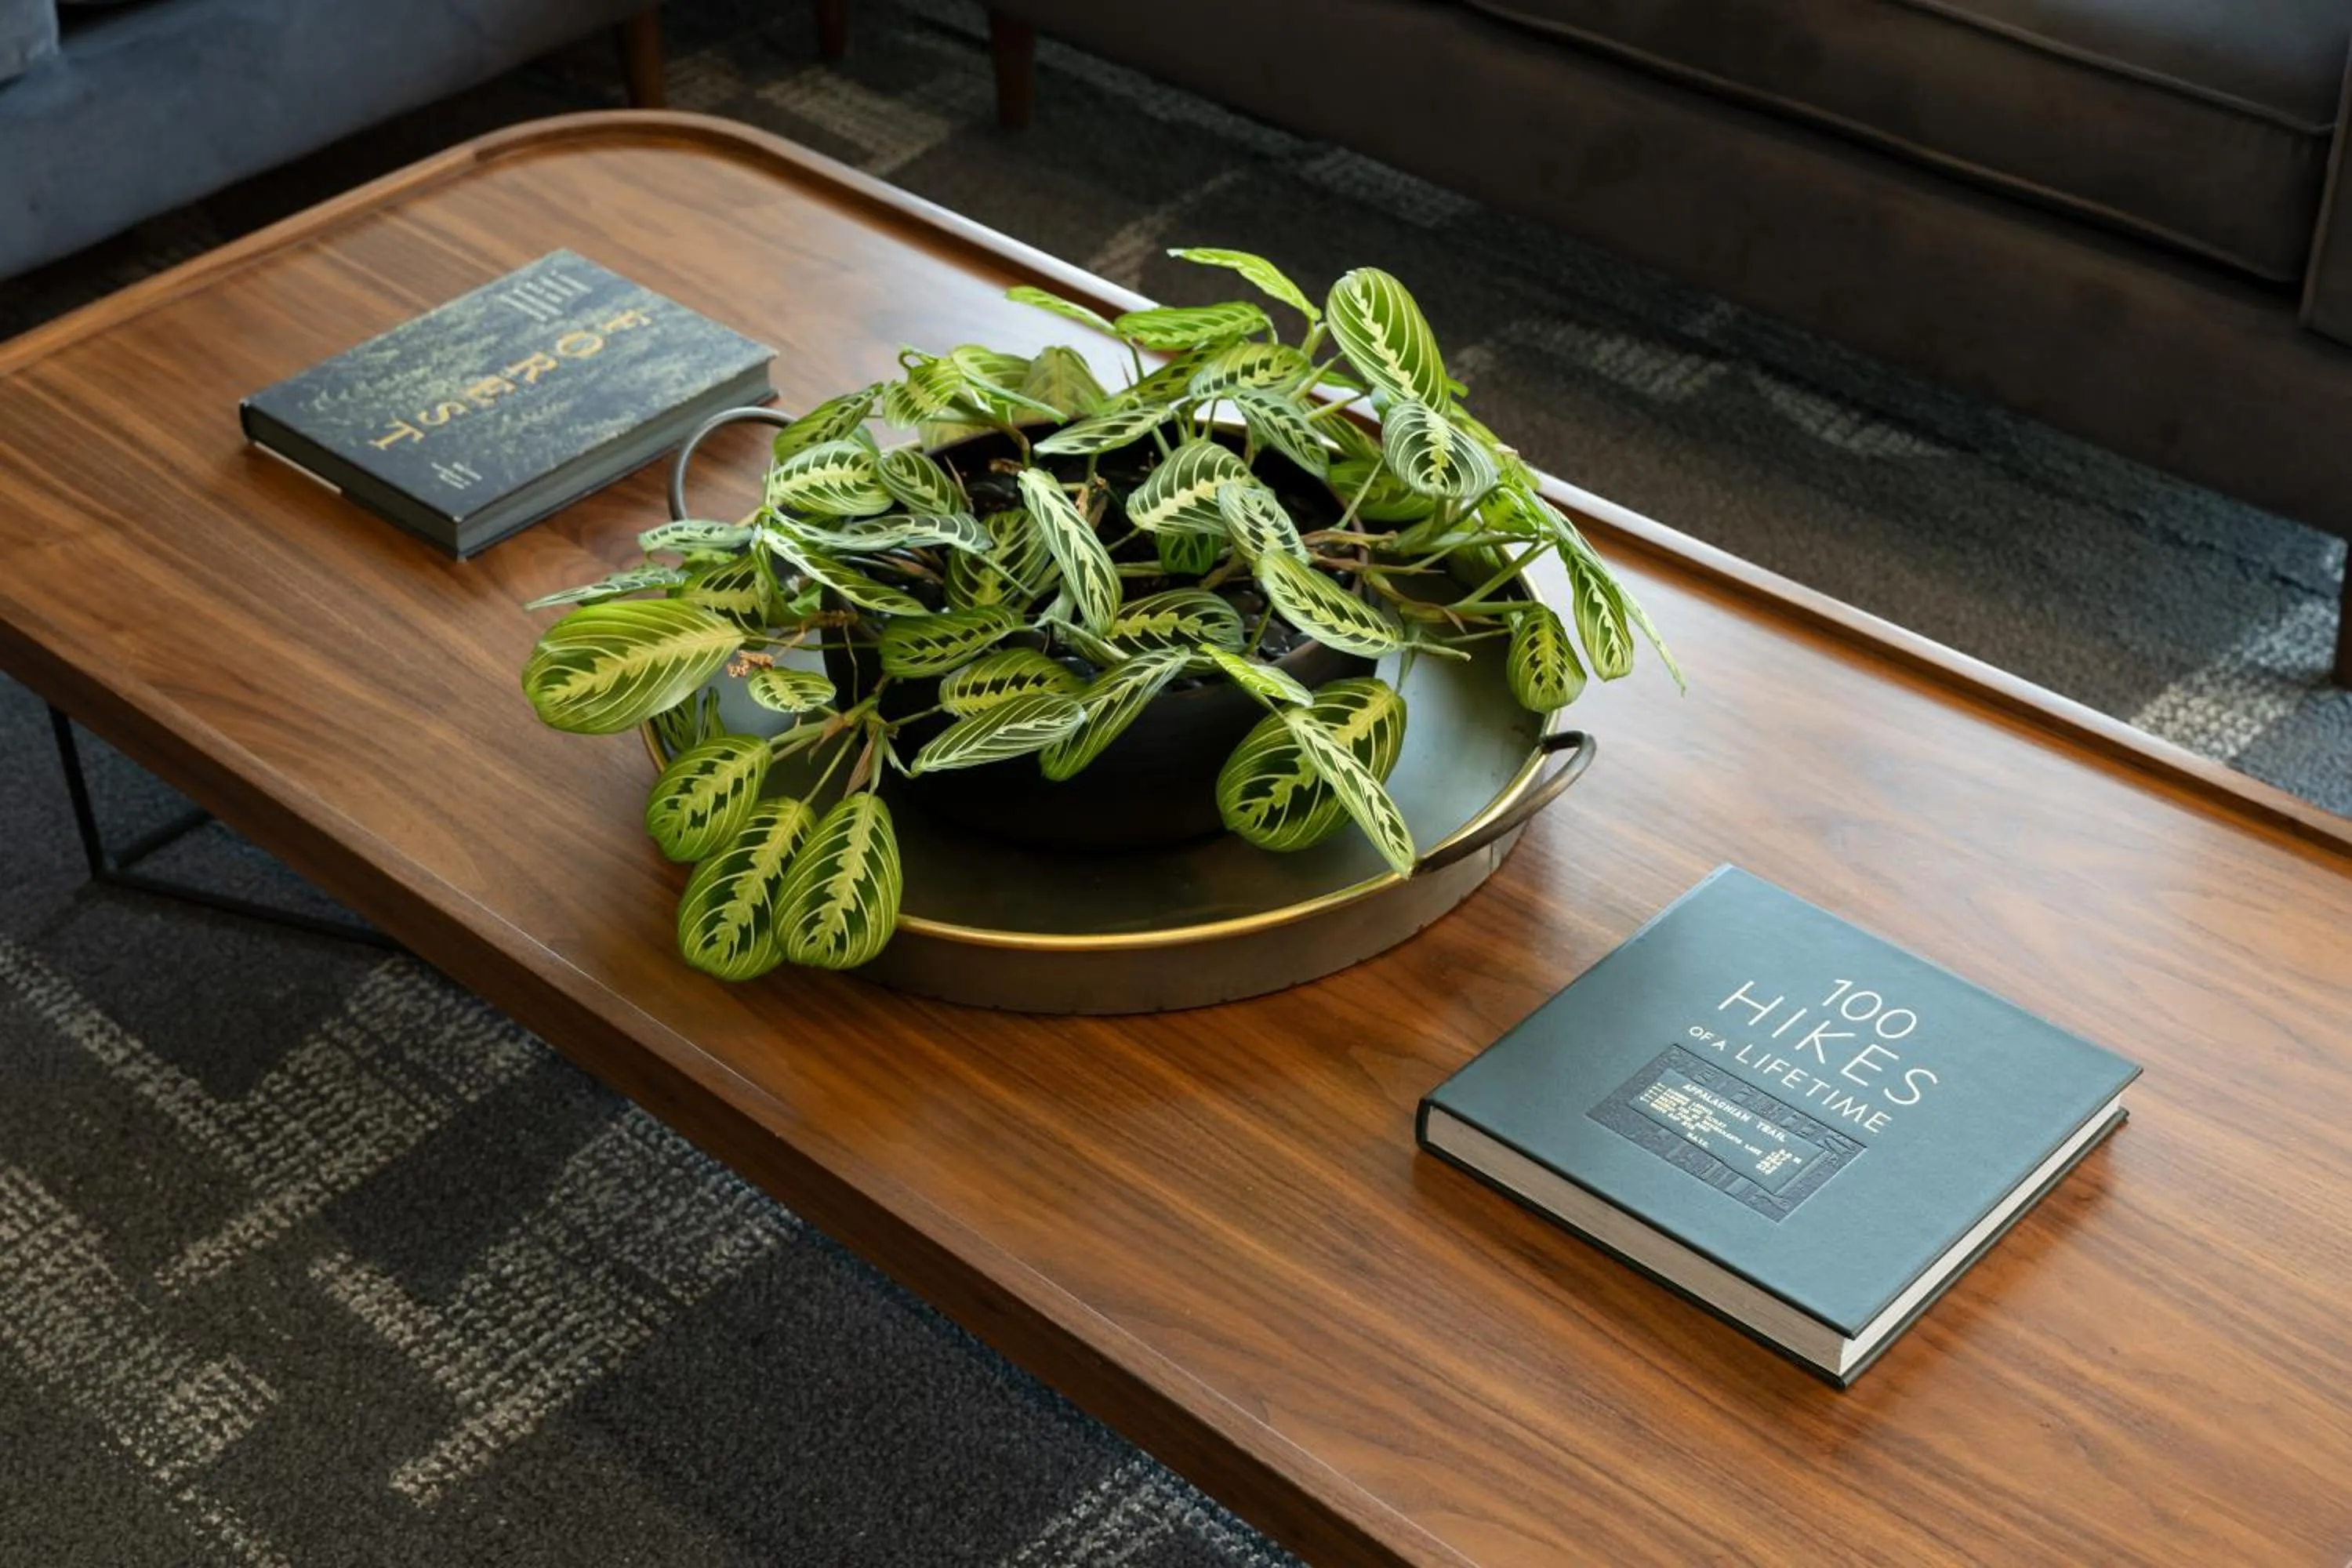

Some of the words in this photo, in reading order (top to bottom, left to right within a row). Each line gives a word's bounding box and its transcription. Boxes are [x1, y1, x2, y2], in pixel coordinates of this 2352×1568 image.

[368, 310, 652, 450] FOREST
[1718, 980, 1939, 1105] HIKES
[1822, 979, 1917, 1039] 100
[1682, 1083, 1752, 1123] APPALACHIAN
[1756, 1121, 1786, 1142] TRAIL
[1689, 1025, 1714, 1042] OF
[1712, 1039, 1726, 1051] A
[1735, 1044, 1893, 1134] LIFETIME
